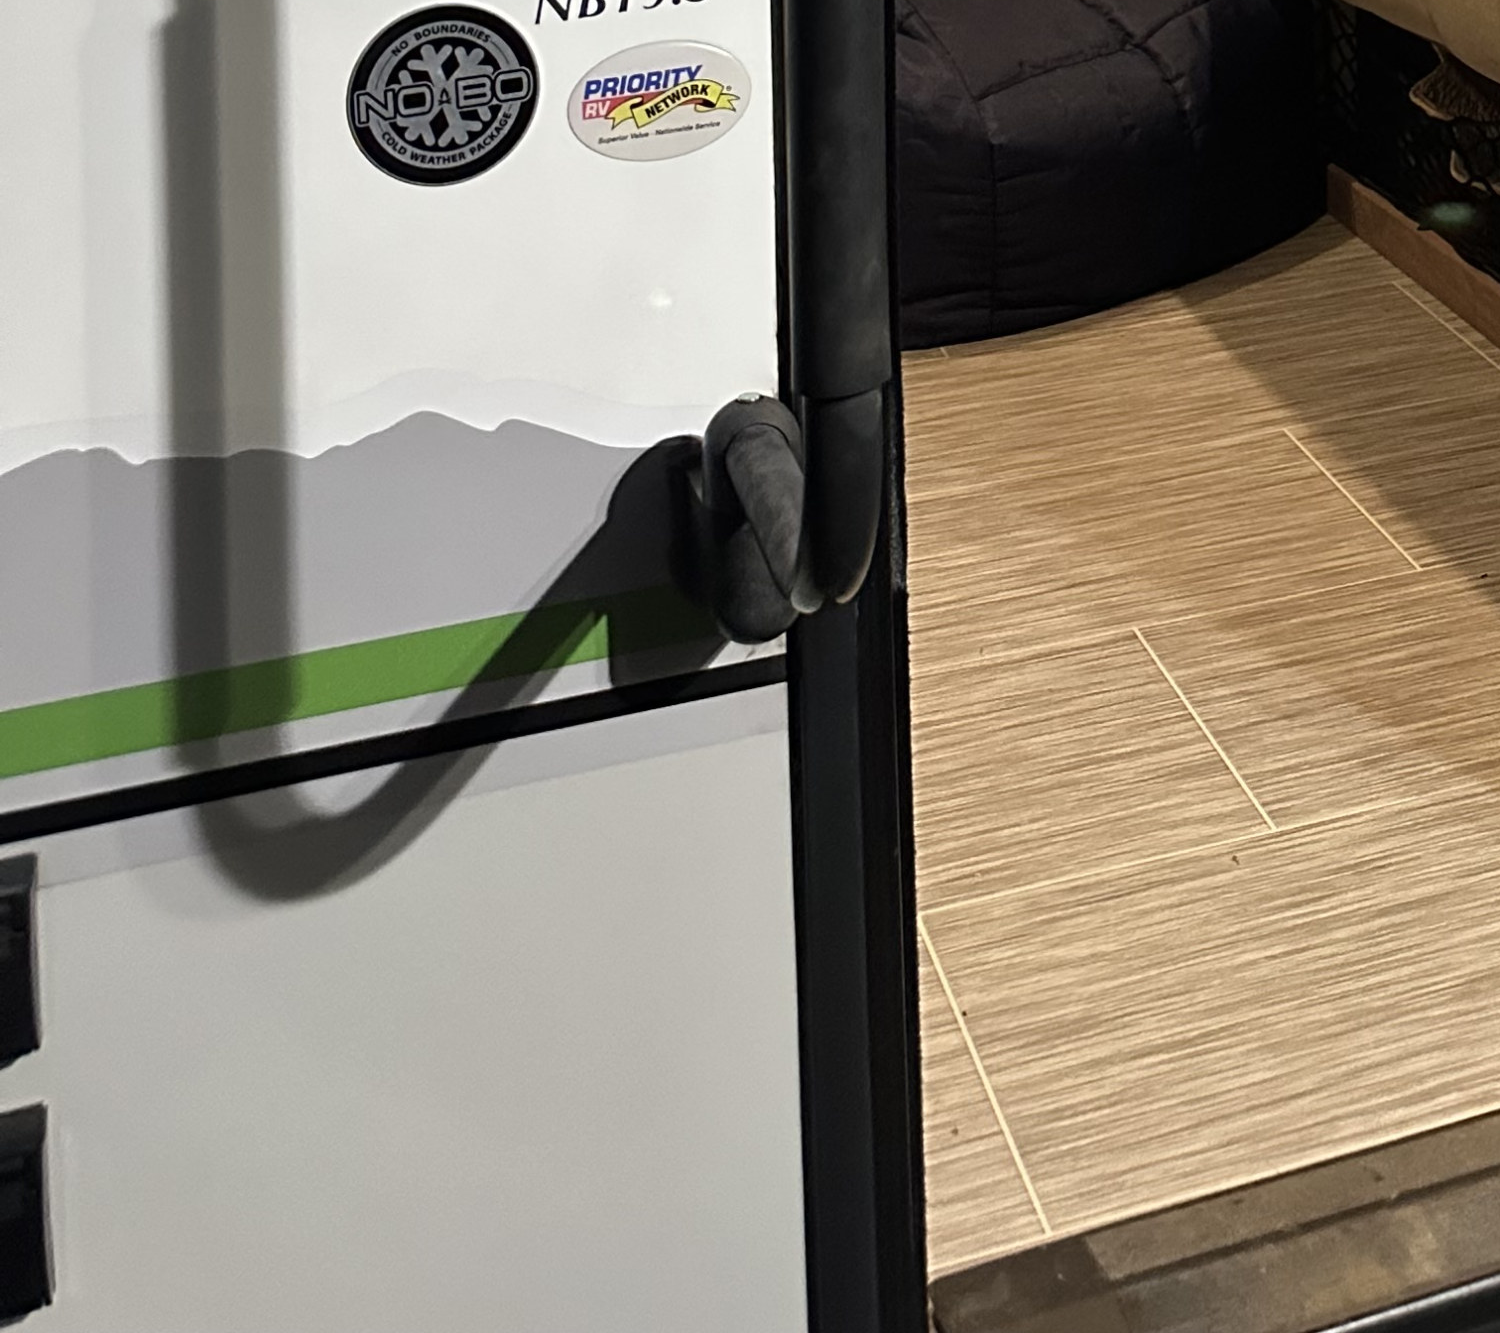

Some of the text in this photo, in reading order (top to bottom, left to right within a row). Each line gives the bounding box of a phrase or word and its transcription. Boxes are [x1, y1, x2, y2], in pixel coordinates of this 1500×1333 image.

[391, 23, 491, 57] NO BOUNDARIES
[583, 64, 703, 100] PRIORITY
[584, 100, 611, 118] RV
[644, 83, 711, 119] NETWORK
[381, 110, 513, 166] COLD WEATHER PACKAGE
